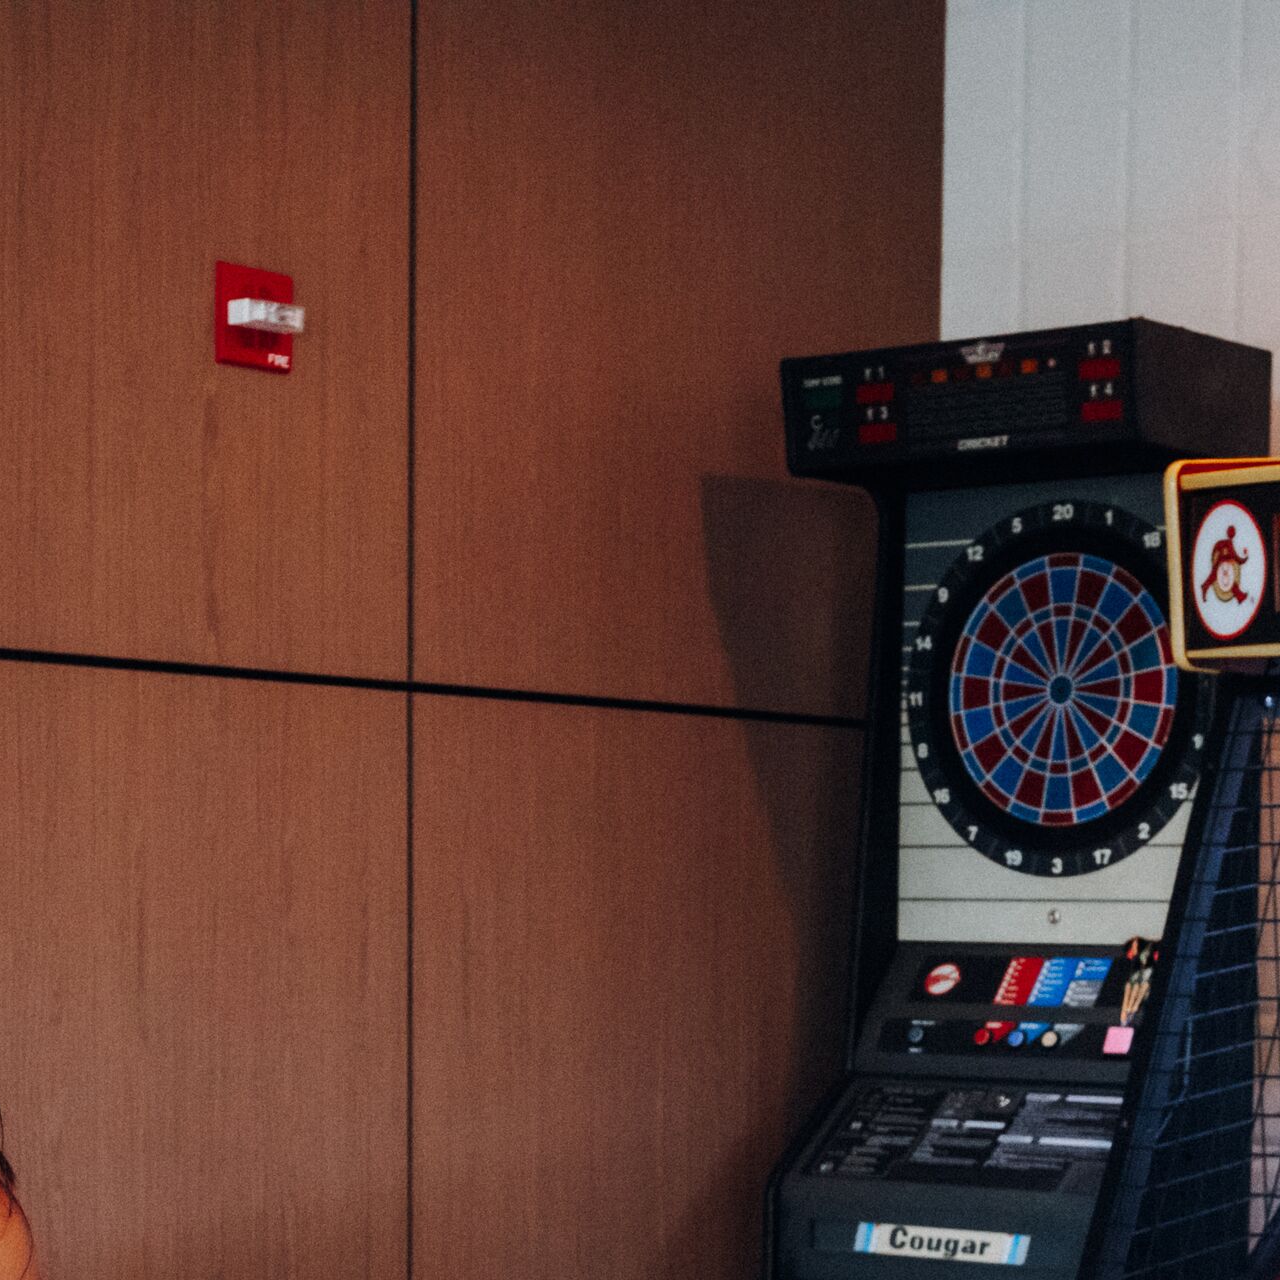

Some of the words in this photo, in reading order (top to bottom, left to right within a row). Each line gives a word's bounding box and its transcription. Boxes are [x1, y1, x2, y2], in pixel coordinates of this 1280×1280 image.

[1052, 504, 1074, 521] 20
[1012, 517, 1022, 533] 5
[967, 546, 984, 561] 12
[937, 587, 949, 603] 9
[915, 636, 932, 650] 14
[1169, 782, 1188, 799] 15
[967, 825, 978, 841] 7
[1138, 822, 1151, 840] 2
[1004, 850, 1023, 867] 19
[1093, 848, 1112, 865] 17
[1051, 857, 1063, 874] 3
[889, 1226, 991, 1258] Cougar
